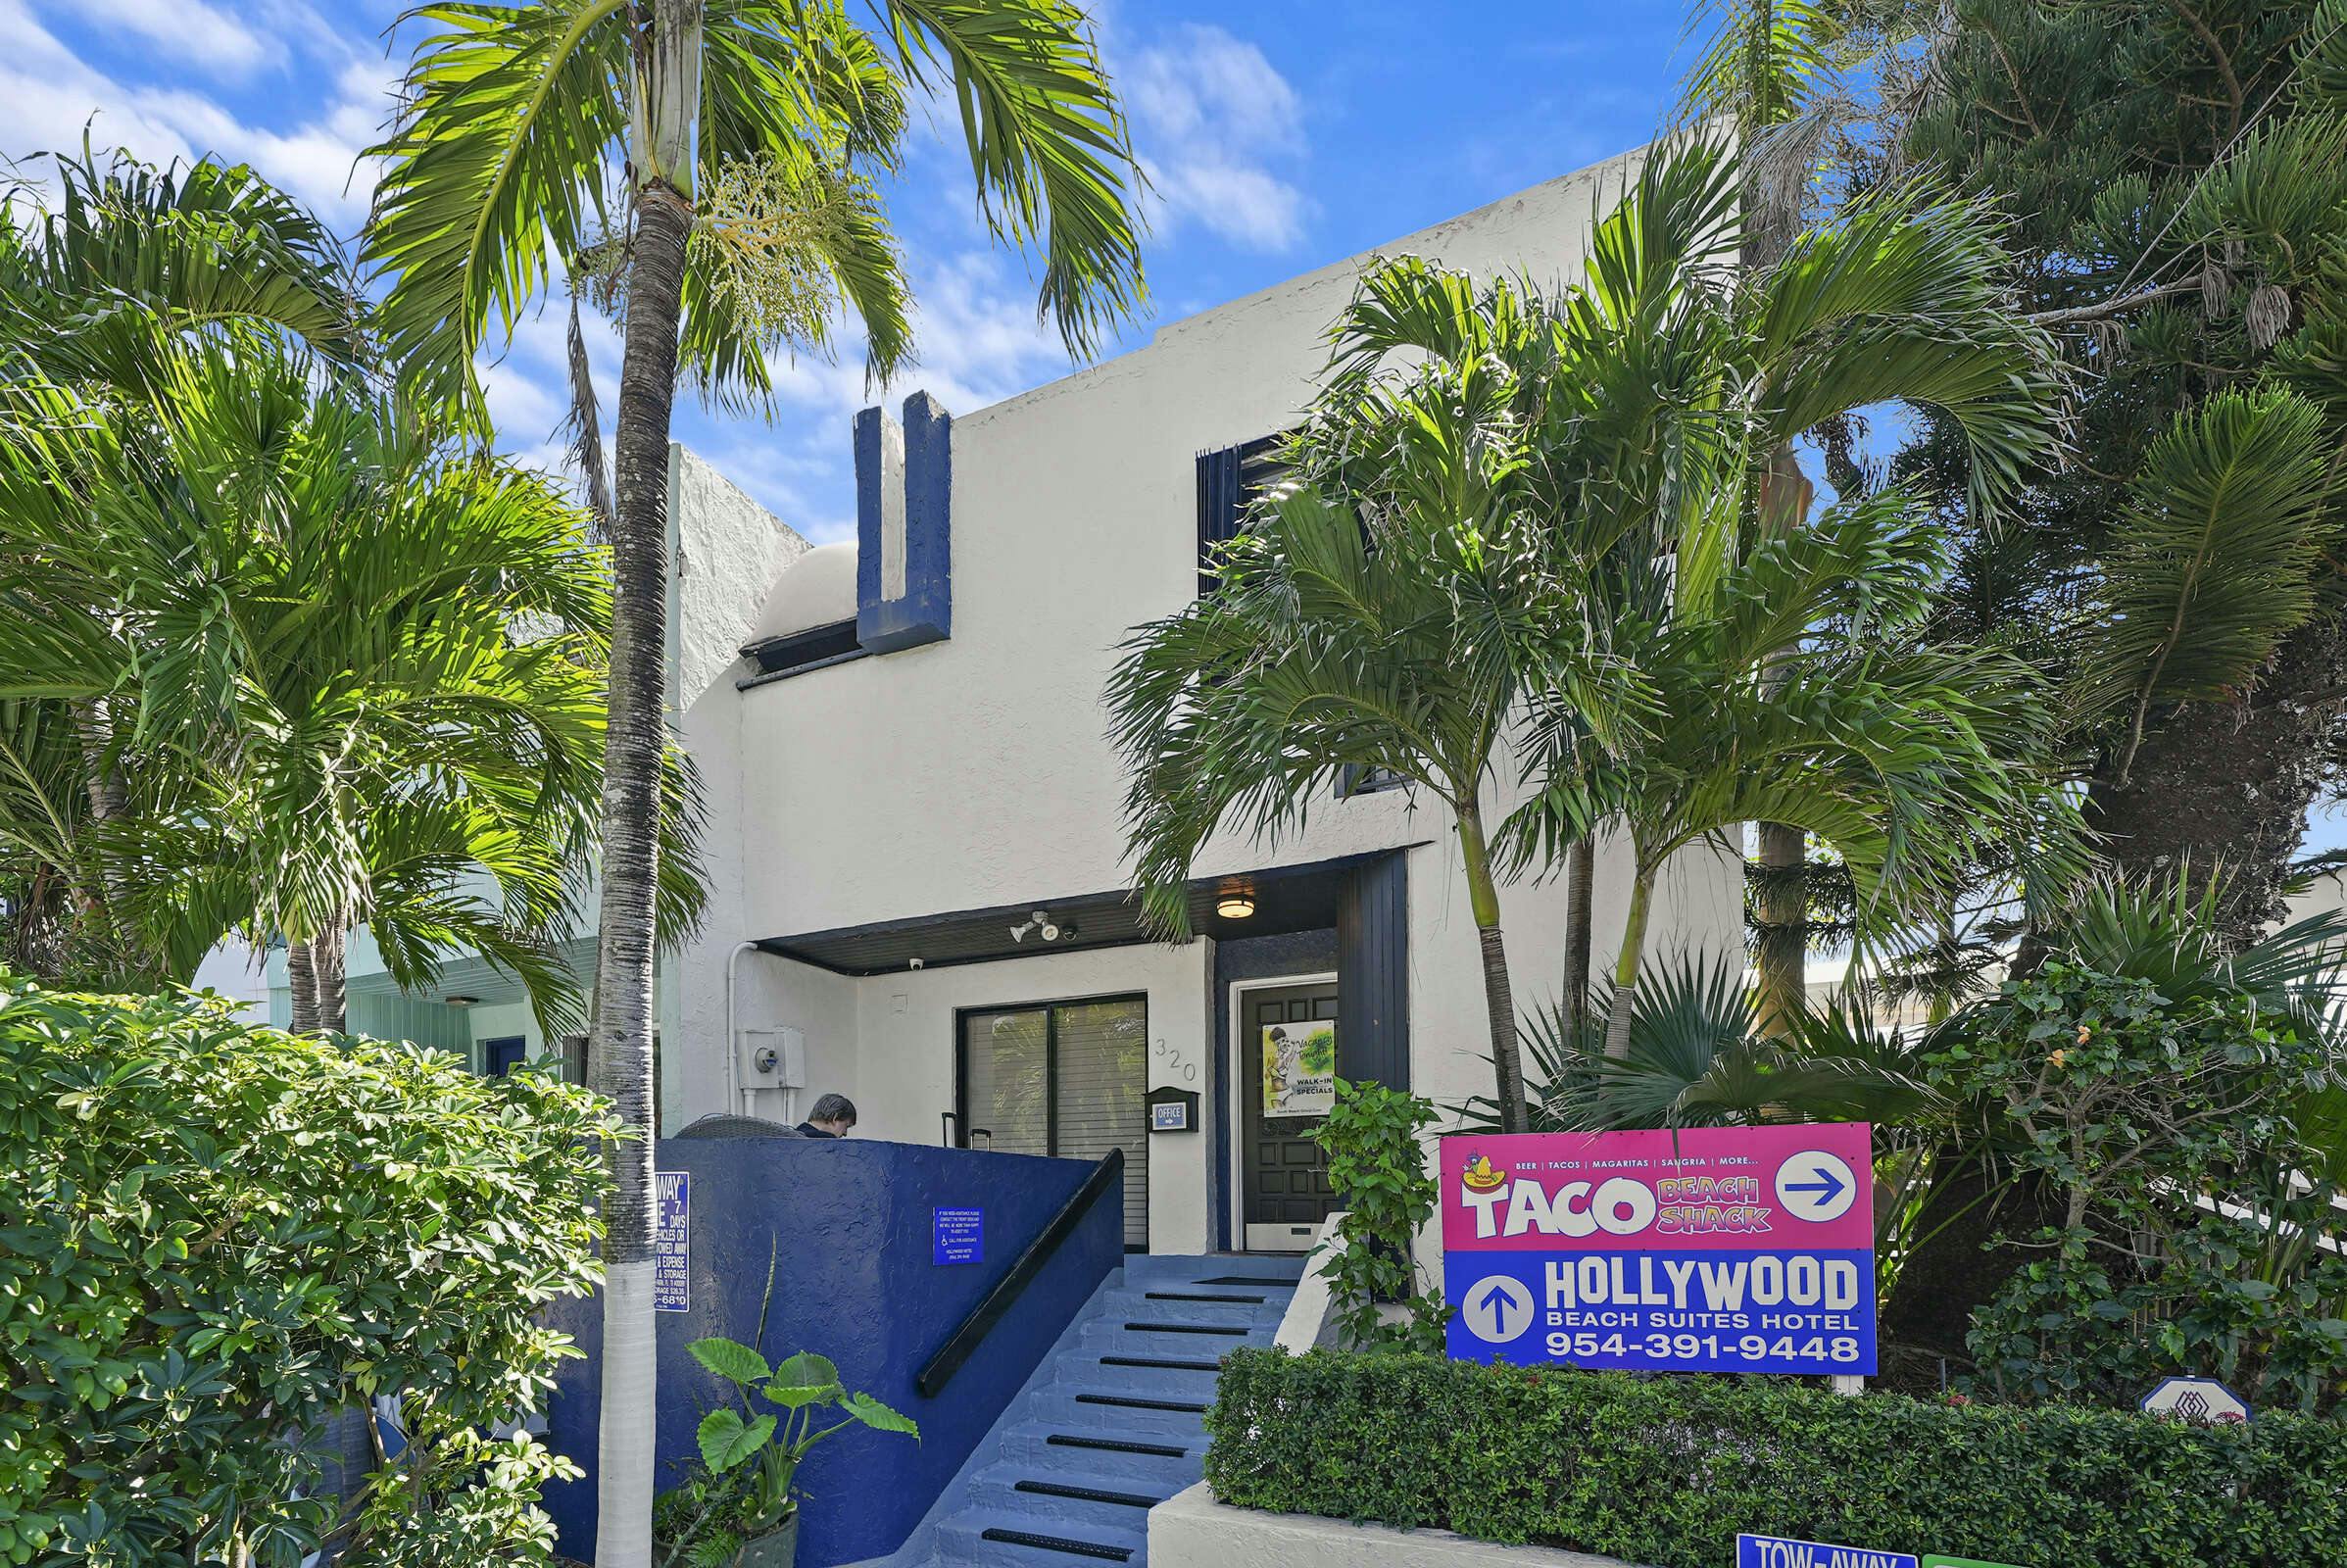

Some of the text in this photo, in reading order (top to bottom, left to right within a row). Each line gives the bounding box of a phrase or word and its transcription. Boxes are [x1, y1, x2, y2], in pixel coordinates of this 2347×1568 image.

[1296, 1036, 1332, 1049] Vacancy
[1155, 1039, 1196, 1081] 320
[1157, 1107, 1181, 1118] OFFICE
[1591, 1159, 1648, 1168] MAGARITAS
[1661, 1157, 1706, 1167] SANGRIA
[657, 1175, 681, 1200] WAY
[1657, 1176, 1759, 1205] BEACH
[675, 1200, 681, 1214] 7
[1461, 1176, 1657, 1239] TACO
[669, 1215, 686, 1229] DAYS
[1657, 1204, 1772, 1234] SHACK
[676, 1230, 685, 1242] OR
[662, 1255, 685, 1268] EXPENSE
[663, 1270, 686, 1279] STORAGE
[1545, 1255, 1859, 1311] HOLLYWOOD
[1546, 1311, 1859, 1331] BEACH SUITES HOTEL
[1545, 1332, 1859, 1362] 954-391-9448
